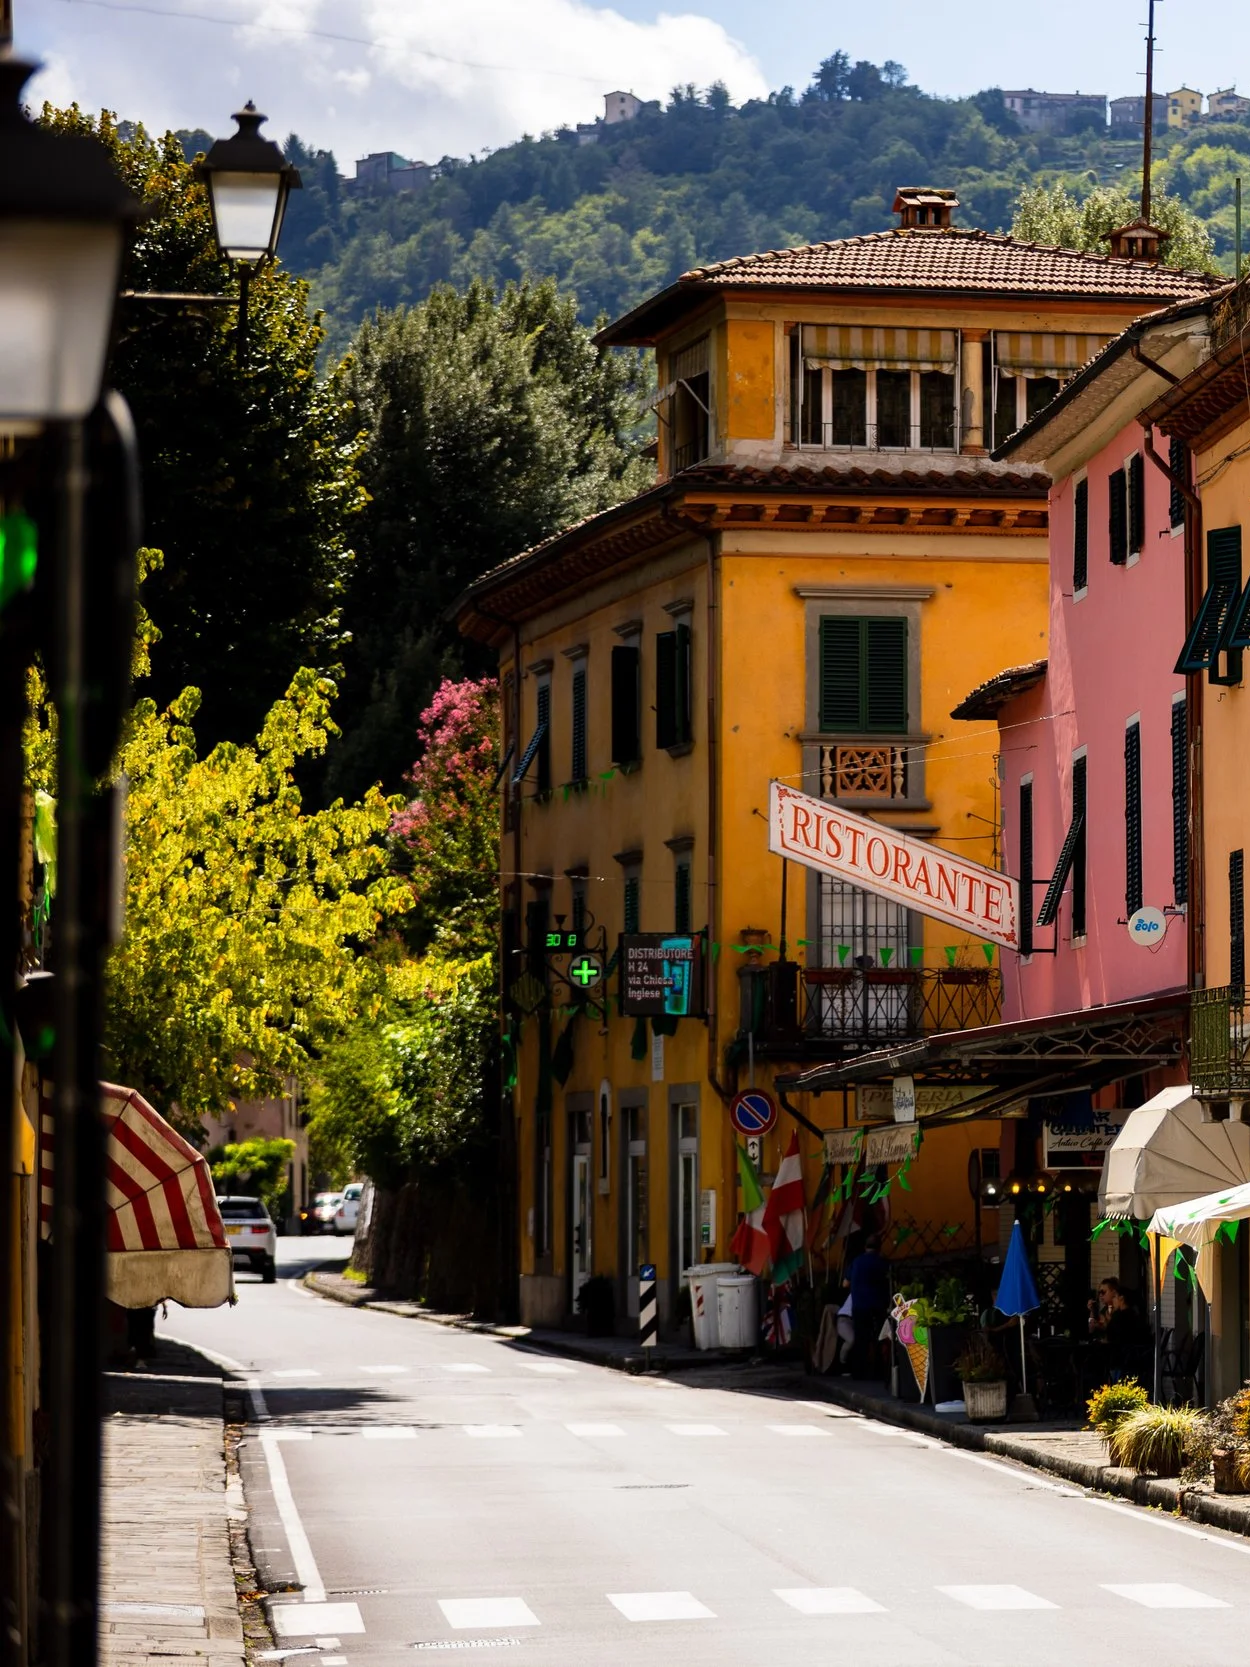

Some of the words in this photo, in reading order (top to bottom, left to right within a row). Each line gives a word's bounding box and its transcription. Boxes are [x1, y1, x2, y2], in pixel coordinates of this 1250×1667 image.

[790, 804, 1002, 925] RISTORANTE
[546, 934, 561, 947] 30
[567, 934, 577, 947] 8
[628, 948, 693, 959] DISTRIBUTORE
[628, 961, 635, 972] H
[637, 961, 648, 972] 24
[628, 975, 641, 985] via
[643, 975, 673, 985] Chiesa
[628, 987, 660, 1000] Inglese
